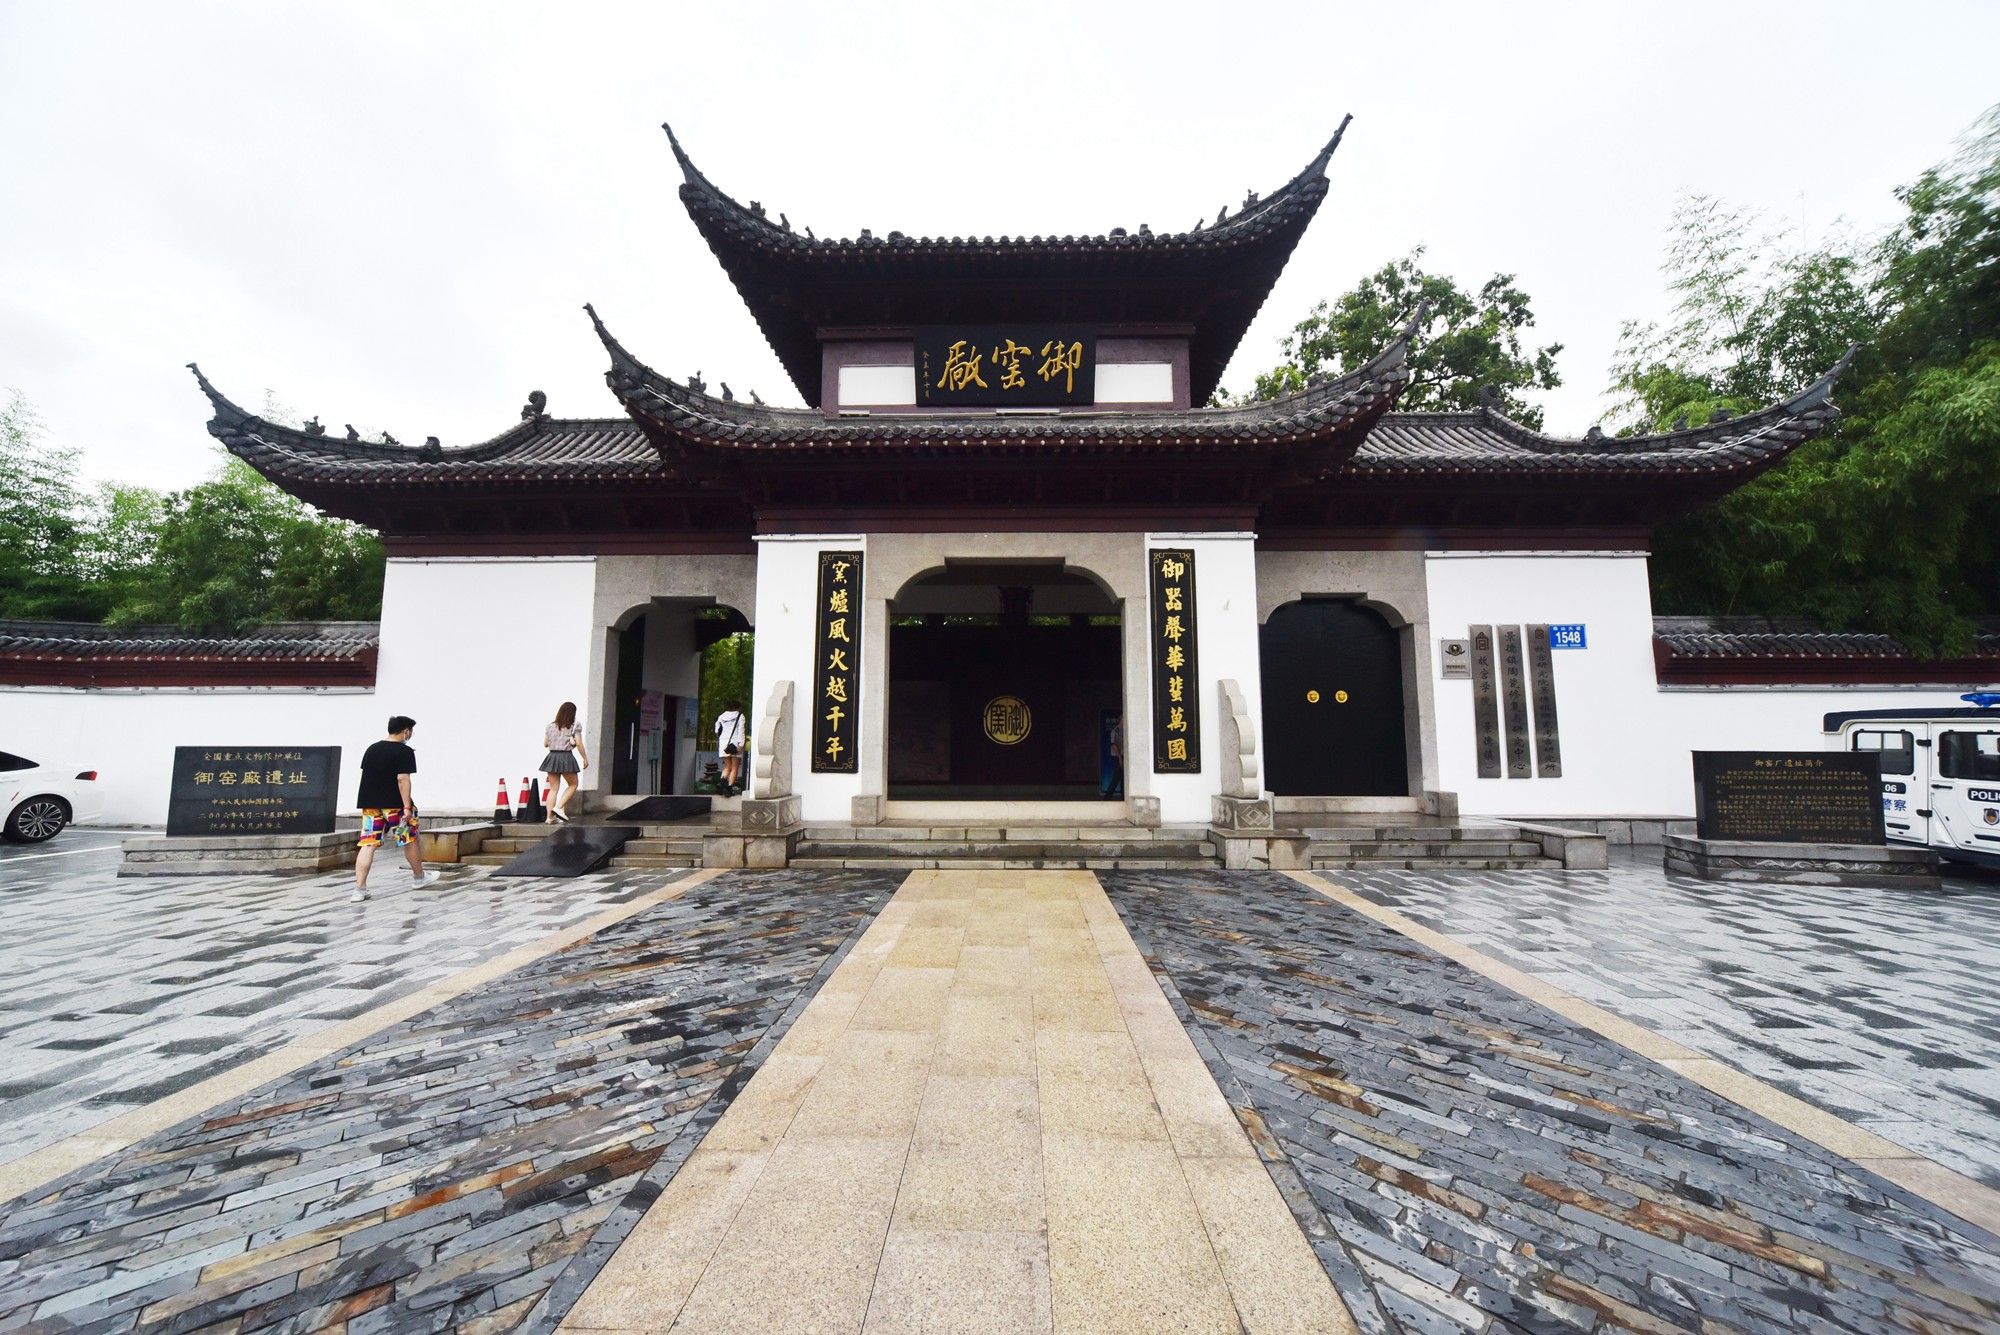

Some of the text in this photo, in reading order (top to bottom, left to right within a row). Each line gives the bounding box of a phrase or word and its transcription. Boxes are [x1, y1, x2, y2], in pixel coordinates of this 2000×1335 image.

[1555, 631, 1581, 644] 1548
[1884, 784, 1897, 792] 06
[1882, 798, 1907, 812] 警察
